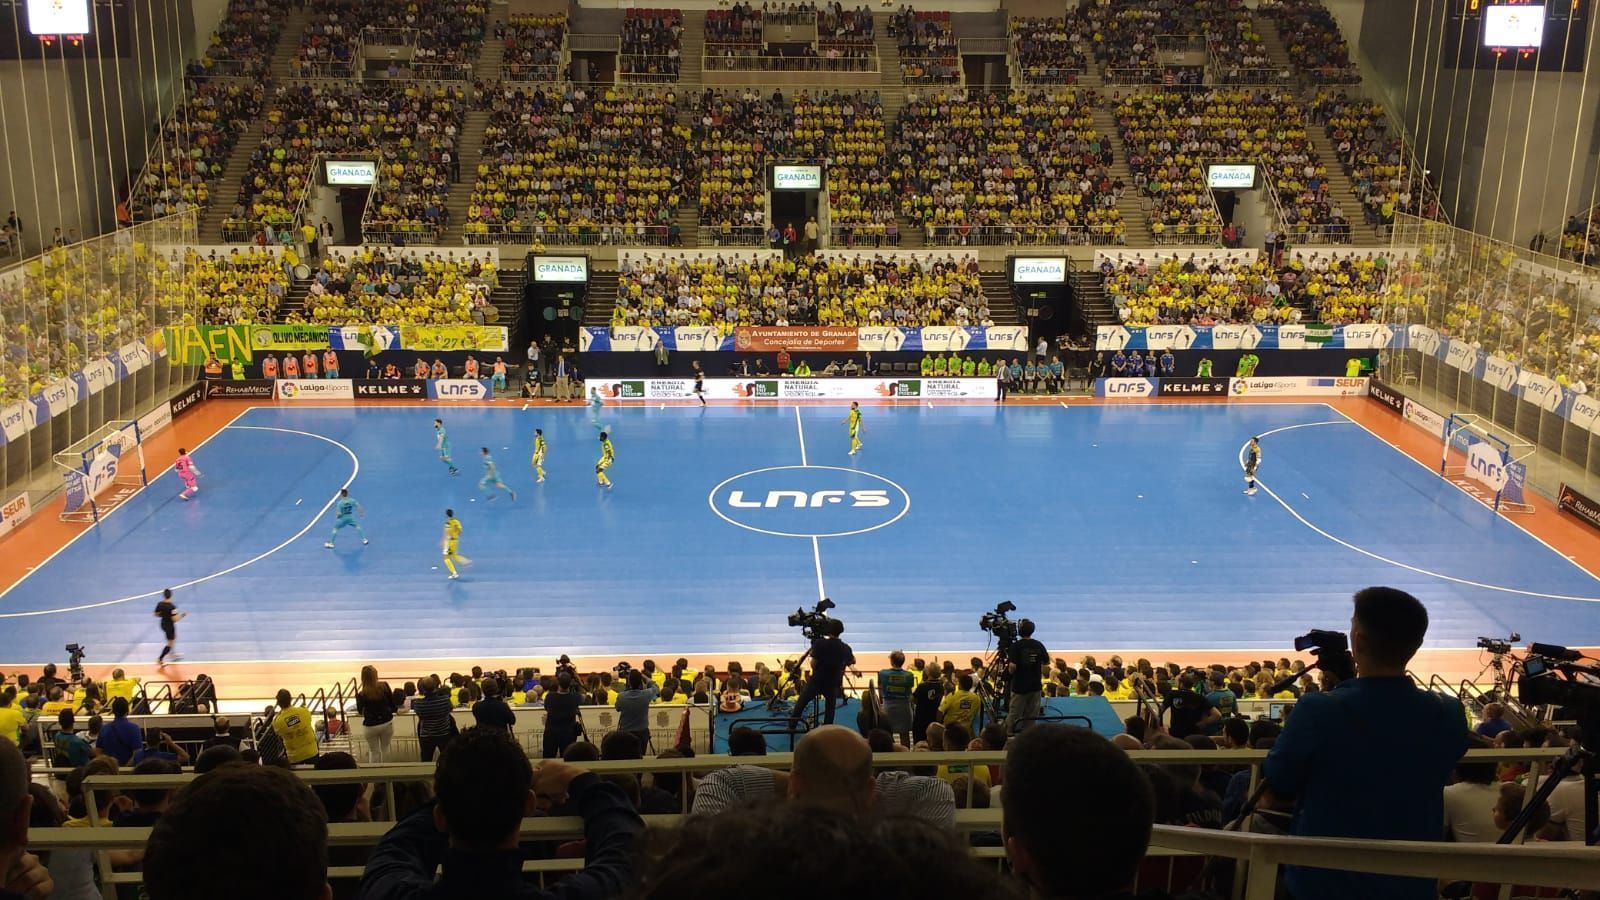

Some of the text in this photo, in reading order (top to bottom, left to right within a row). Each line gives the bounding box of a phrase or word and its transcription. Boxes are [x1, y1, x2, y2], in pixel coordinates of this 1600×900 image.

[538, 264, 583, 272] GRANADA
[273, 332, 328, 343] OLIVO MECANICO
[442, 338, 458, 348] 27
[166, 325, 253, 366] JAEN
[359, 385, 408, 394] KELME
[441, 384, 478, 395] LNFS
[1109, 383, 1145, 393] LNFS
[1336, 379, 1365, 387] SEUR
[48, 389, 65, 404] LNFS
[1370, 387, 1395, 405] KELME
[172, 393, 196, 413] KELME
[1574, 402, 1595, 418] LNFS
[728, 490, 890, 508] LNFS
[3, 497, 26, 520] SEUR
